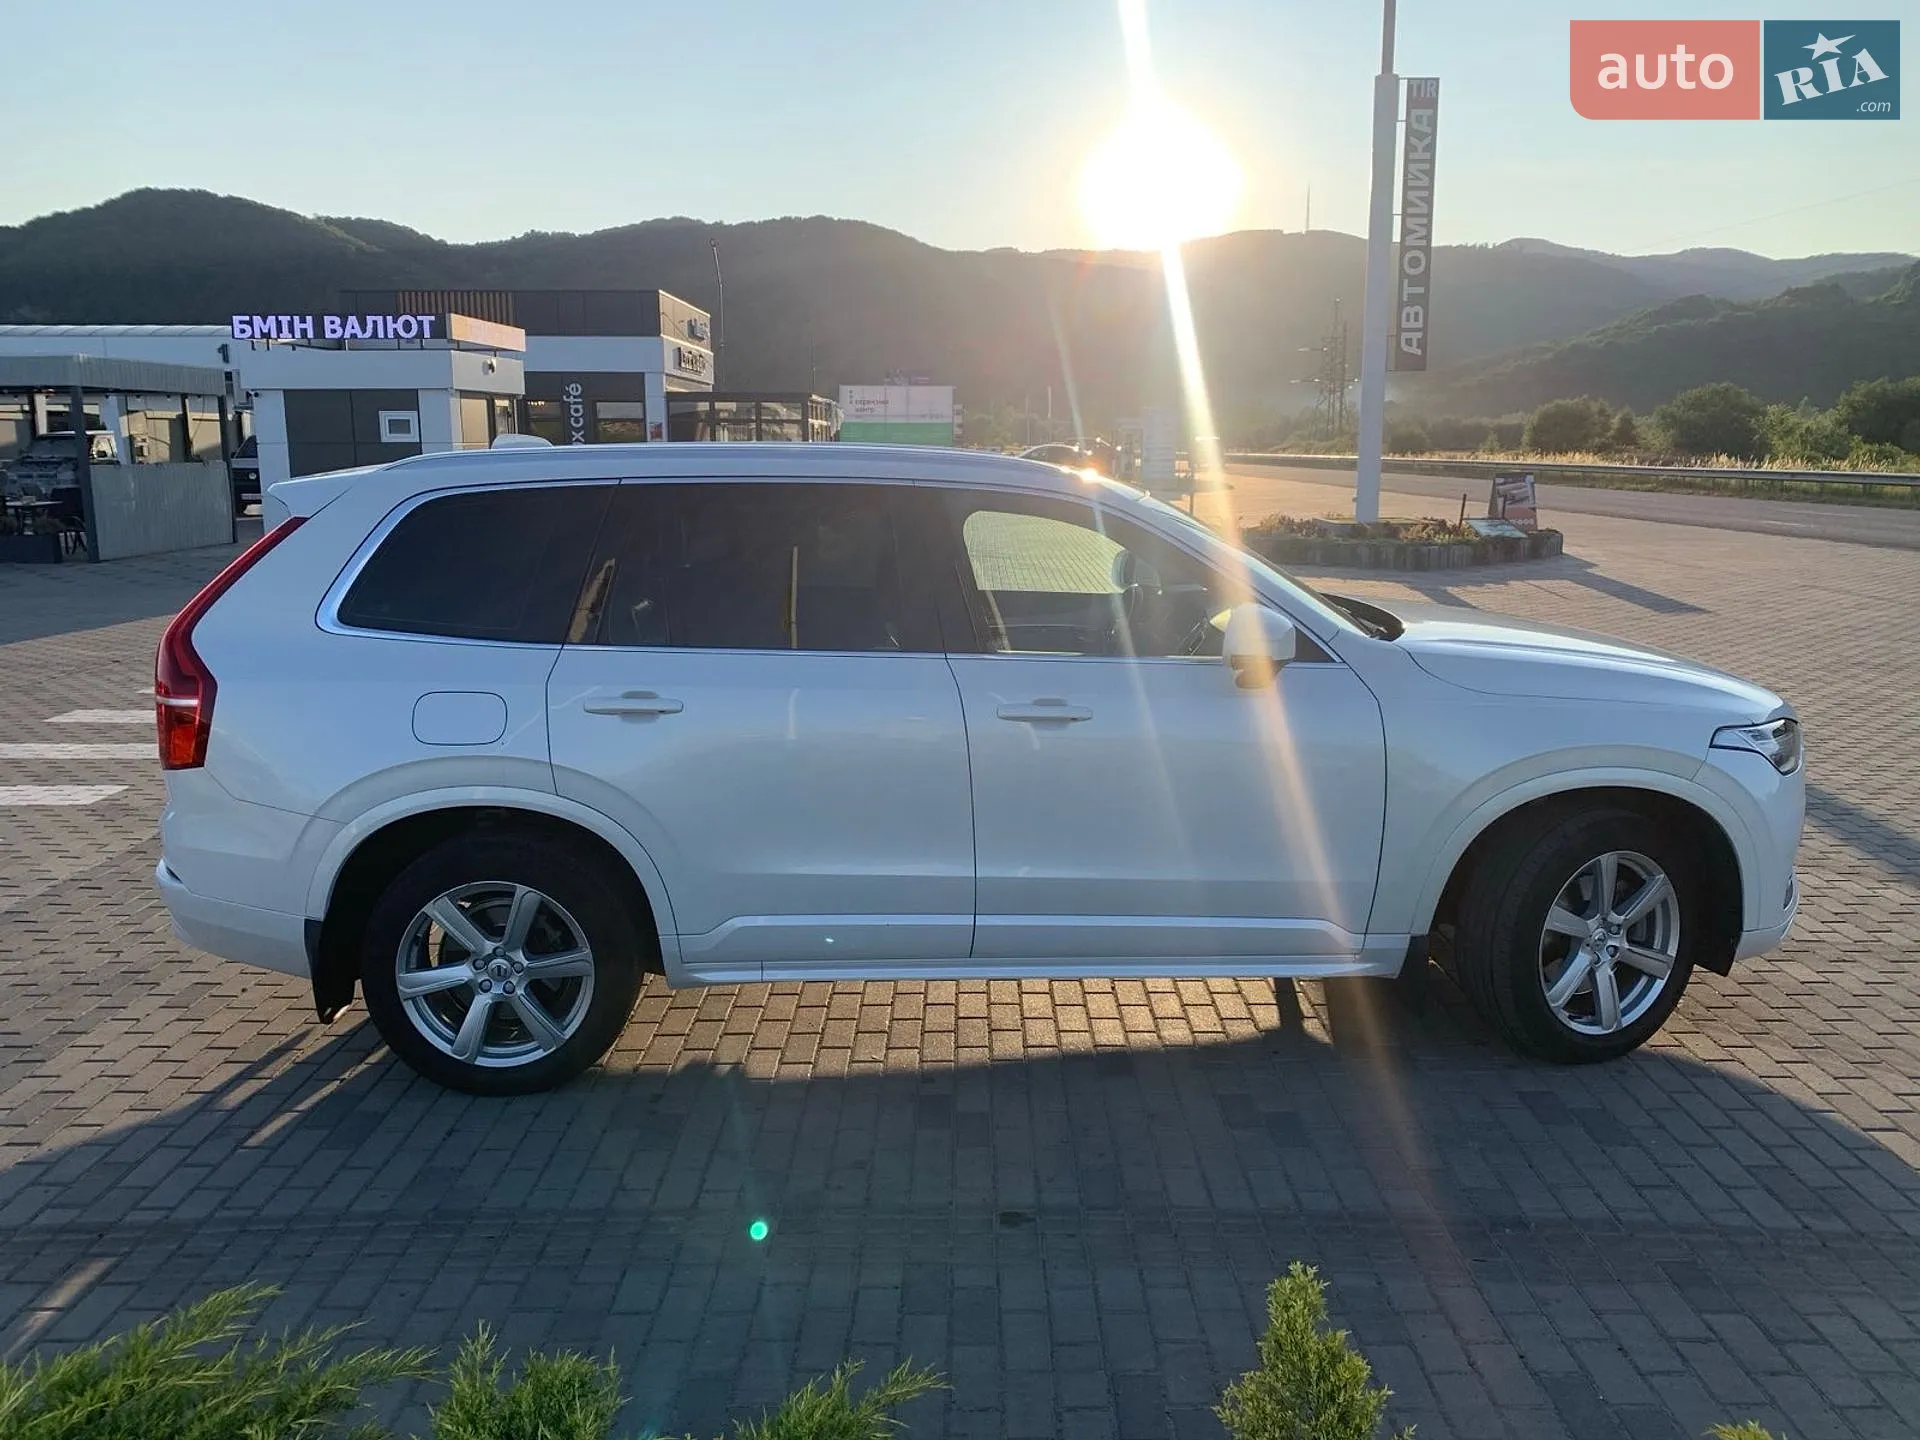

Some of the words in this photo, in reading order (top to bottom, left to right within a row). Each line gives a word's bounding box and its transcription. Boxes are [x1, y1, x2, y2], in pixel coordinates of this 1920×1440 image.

[1410, 80, 1438, 98] TIR
[231, 315, 314, 339] БМІН
[323, 314, 436, 339] ВАЛЮТ
[562, 382, 584, 428] café
